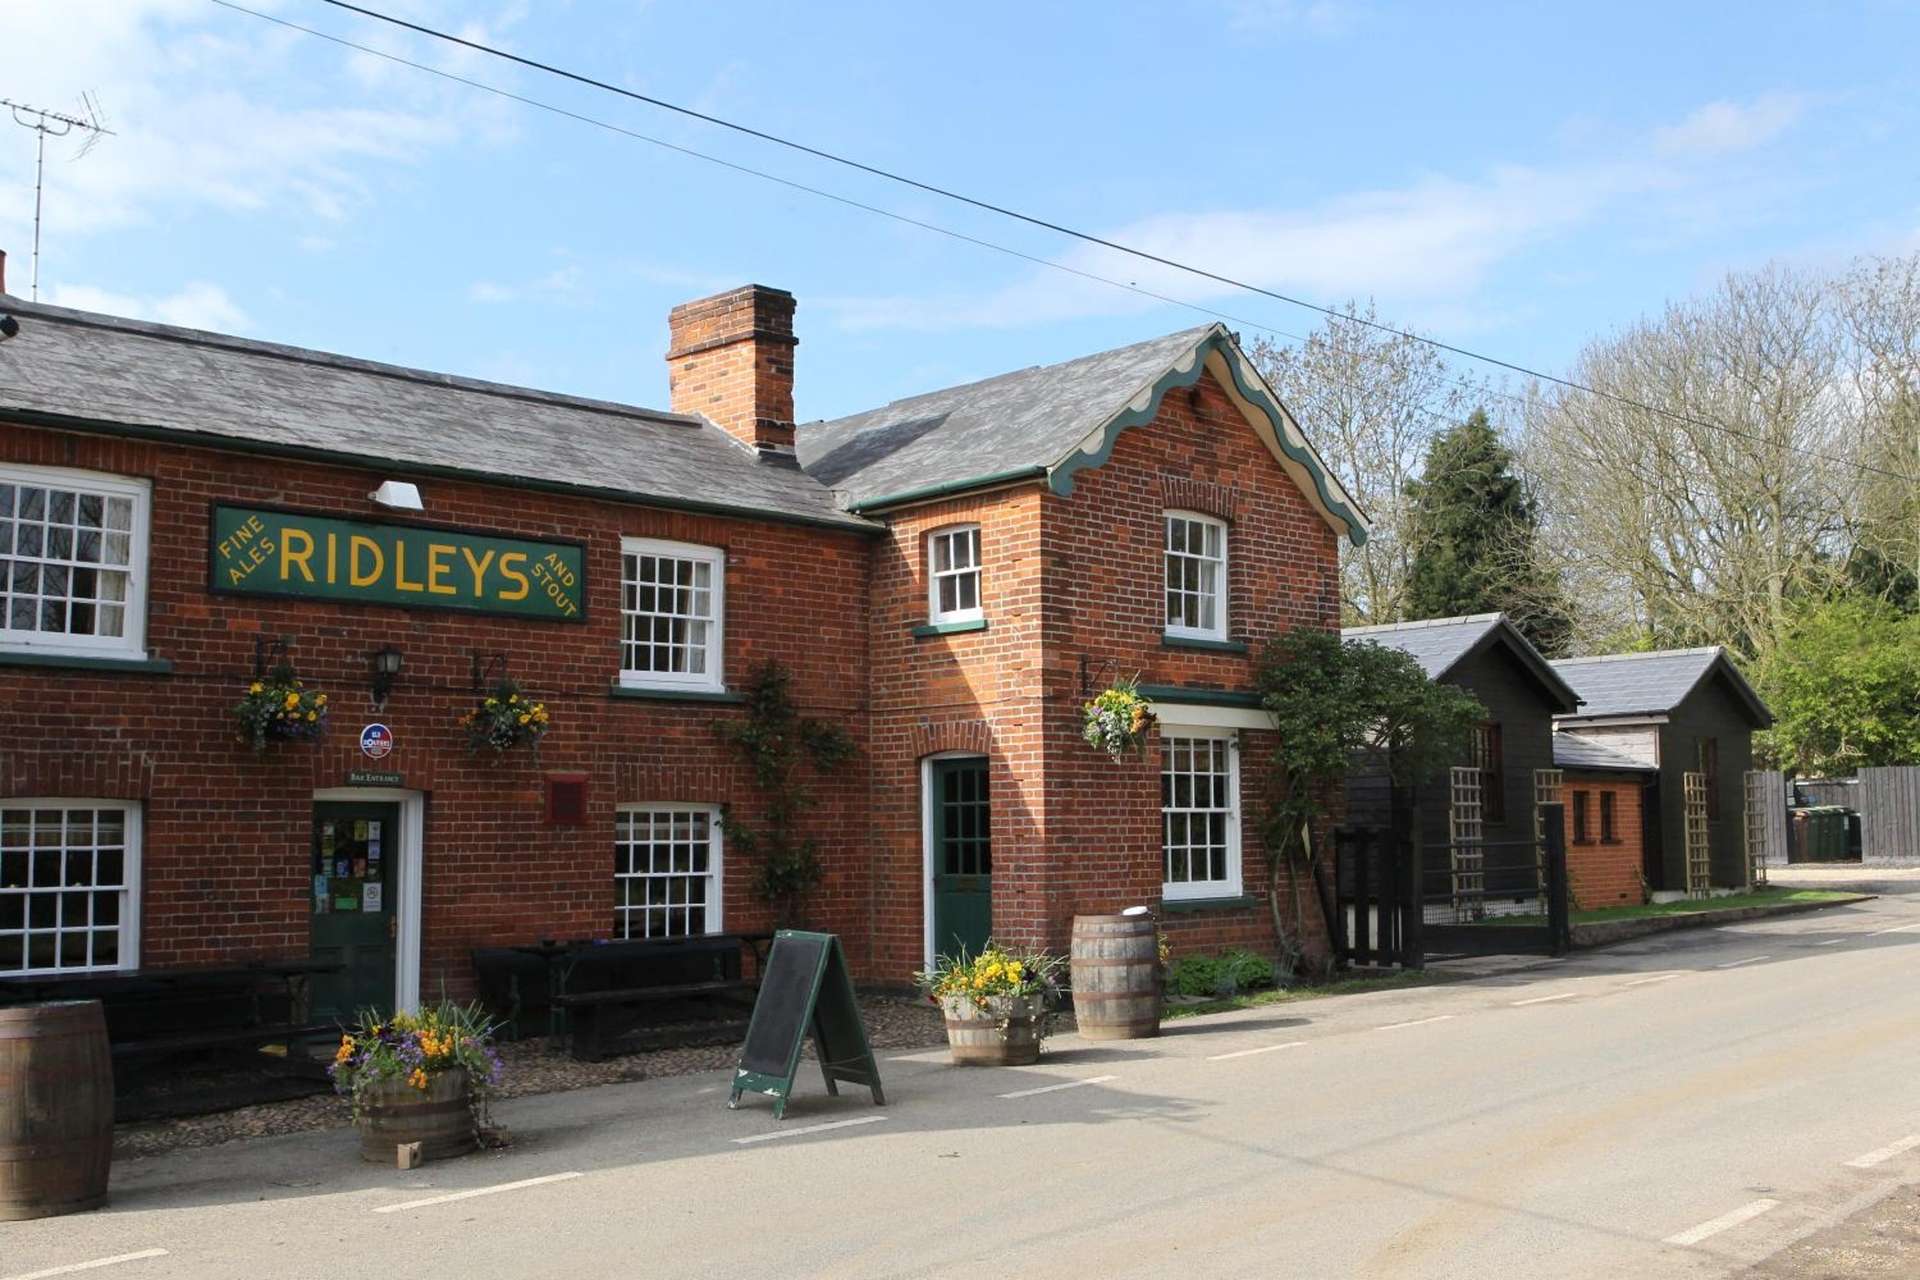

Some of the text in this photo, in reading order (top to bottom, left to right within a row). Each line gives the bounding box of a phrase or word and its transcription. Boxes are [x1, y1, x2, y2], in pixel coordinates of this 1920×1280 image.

[218, 515, 265, 559] FINE
[229, 537, 275, 585] ALES
[280, 528, 530, 601] RIDLEYS
[544, 553, 575, 586] AND
[531, 563, 577, 616] STOUT
